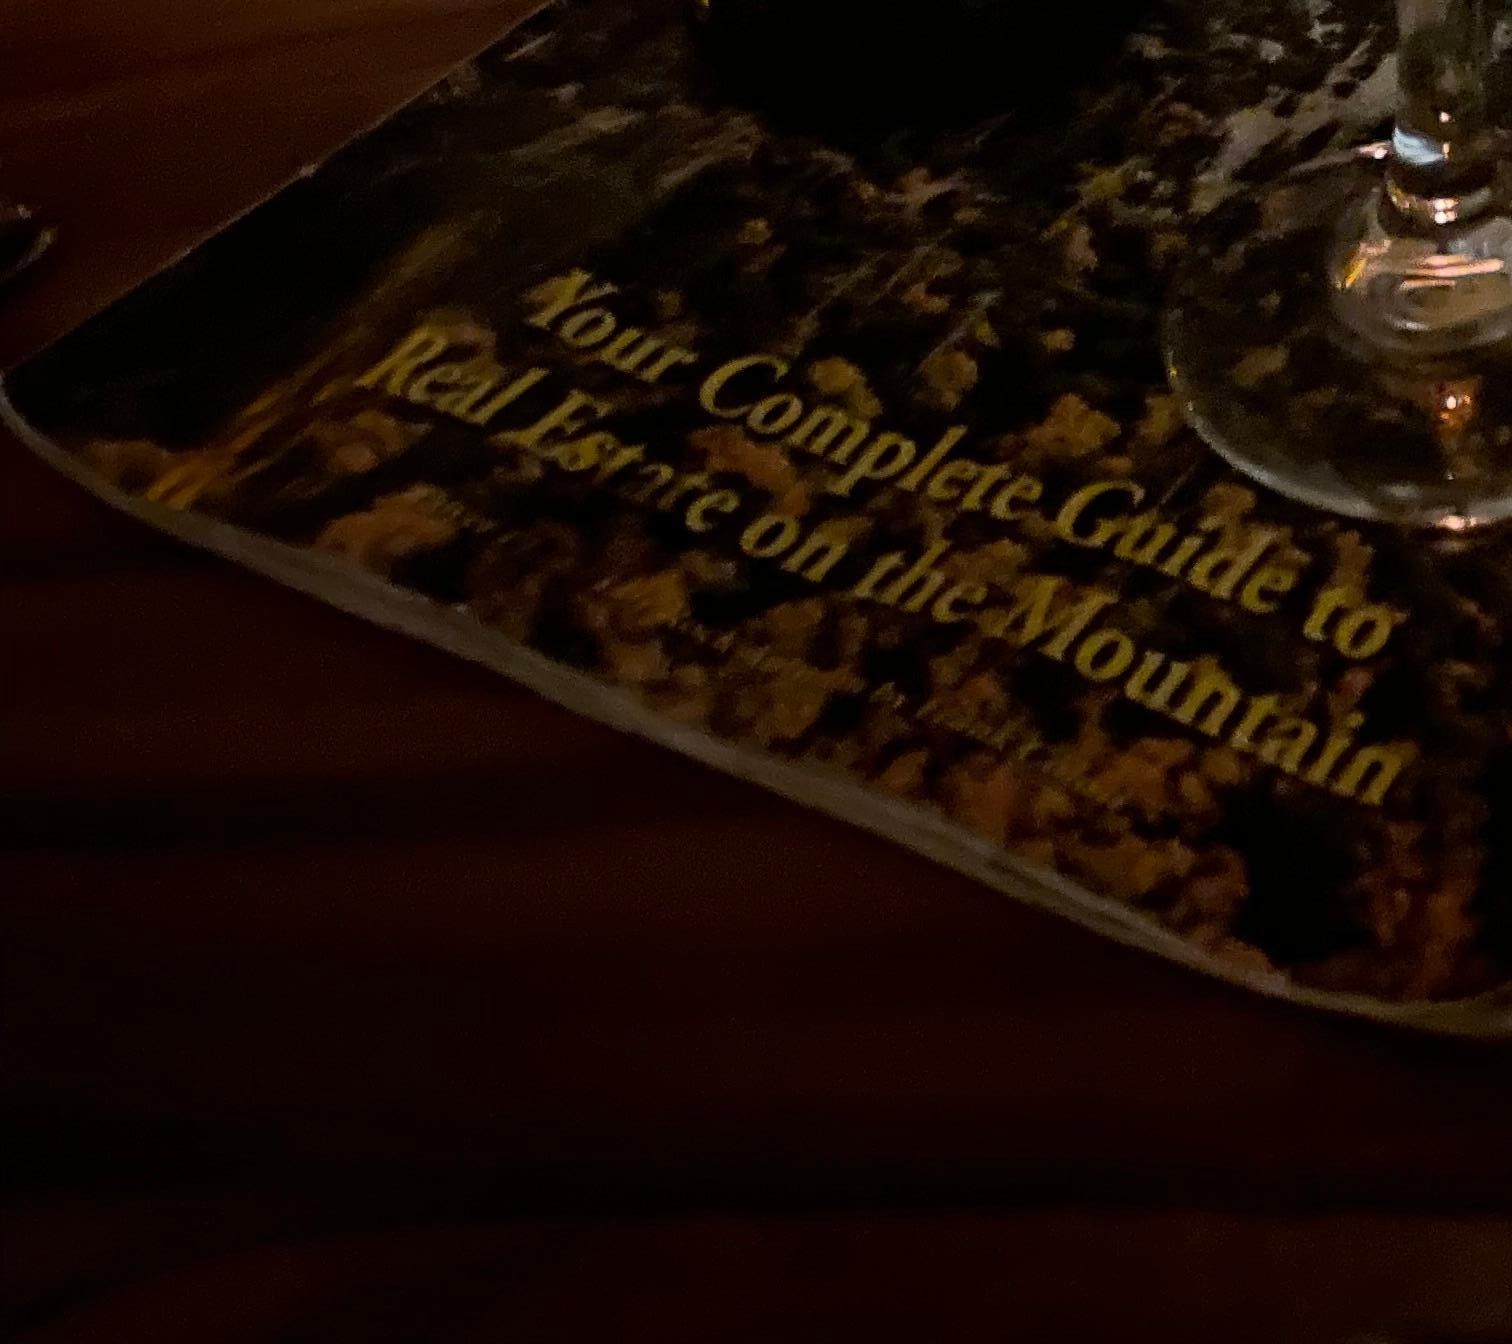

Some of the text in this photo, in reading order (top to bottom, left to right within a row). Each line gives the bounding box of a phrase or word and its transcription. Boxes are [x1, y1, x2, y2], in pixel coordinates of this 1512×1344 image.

[354, 321, 552, 426] Real
[489, 388, 743, 534] Estate
[739, 512, 850, 583] on
[853, 537, 989, 624] the
[1006, 574, 1412, 807] Mountain
[521, 266, 1402, 660] Your Complete Guide to
